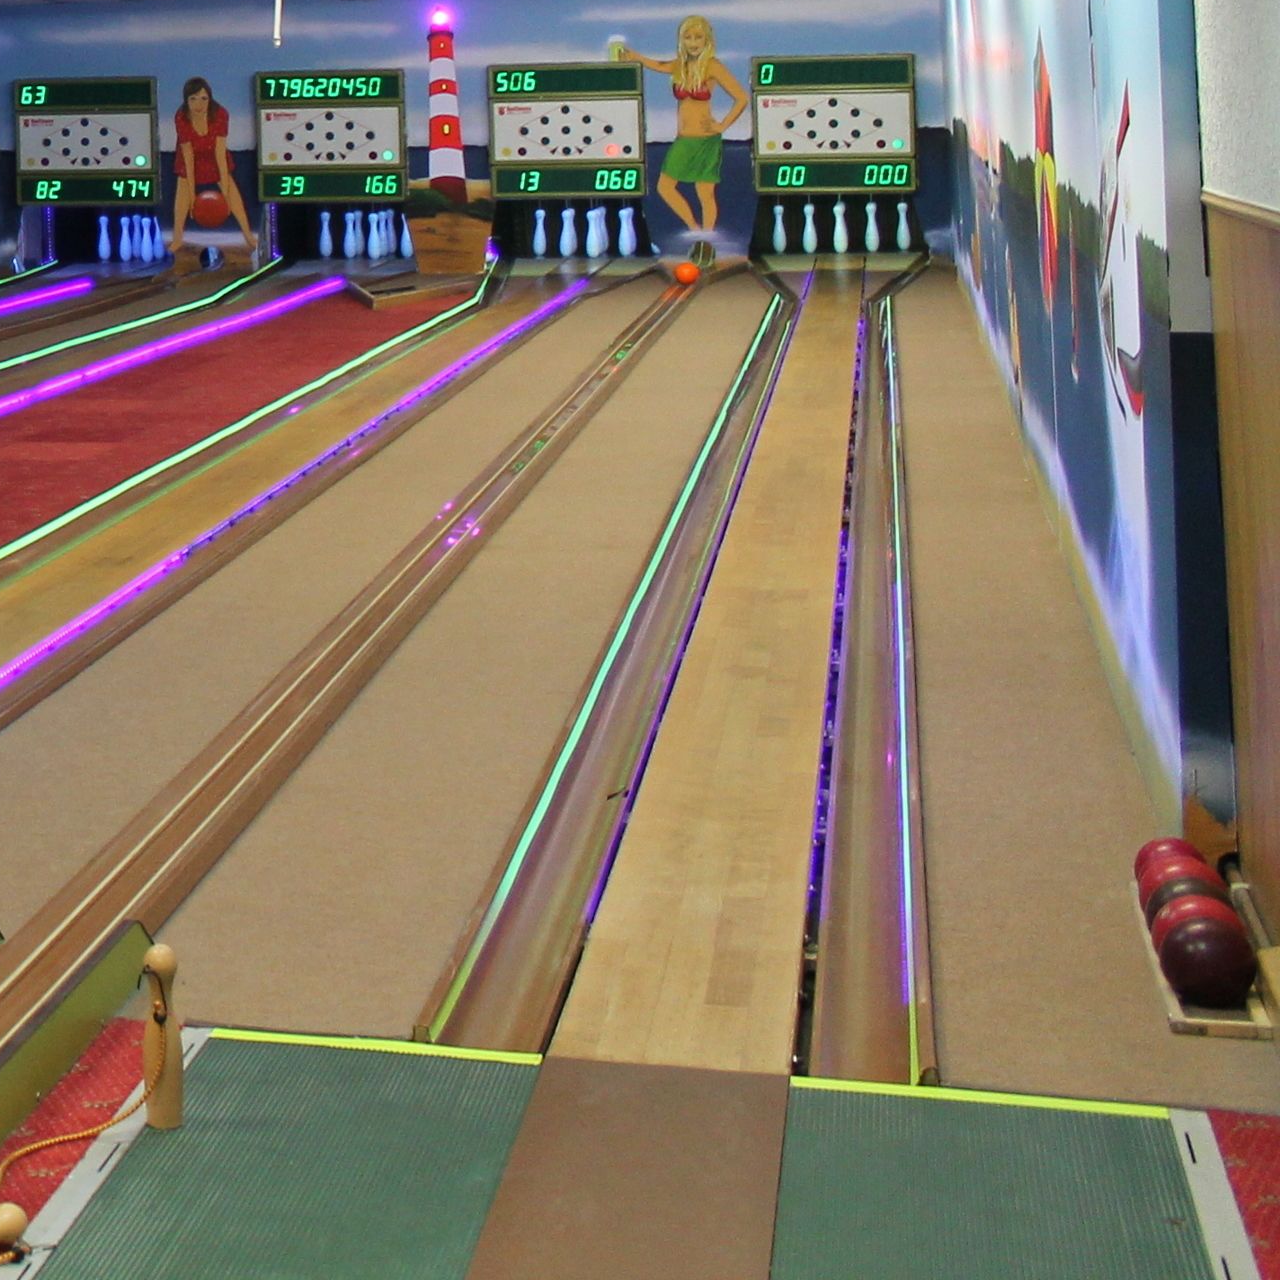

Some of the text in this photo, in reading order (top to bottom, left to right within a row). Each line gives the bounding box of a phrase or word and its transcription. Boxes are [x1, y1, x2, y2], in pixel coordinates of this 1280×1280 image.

[496, 71, 536, 93] 506
[760, 64, 775, 85] 0
[20, 86, 47, 105] 63
[265, 76, 382, 98] 779620450
[279, 174, 398, 196] 39 166
[519, 169, 638, 191] 13 068
[776, 164, 909, 187] 00 000
[35, 179, 150, 200] 82 474
